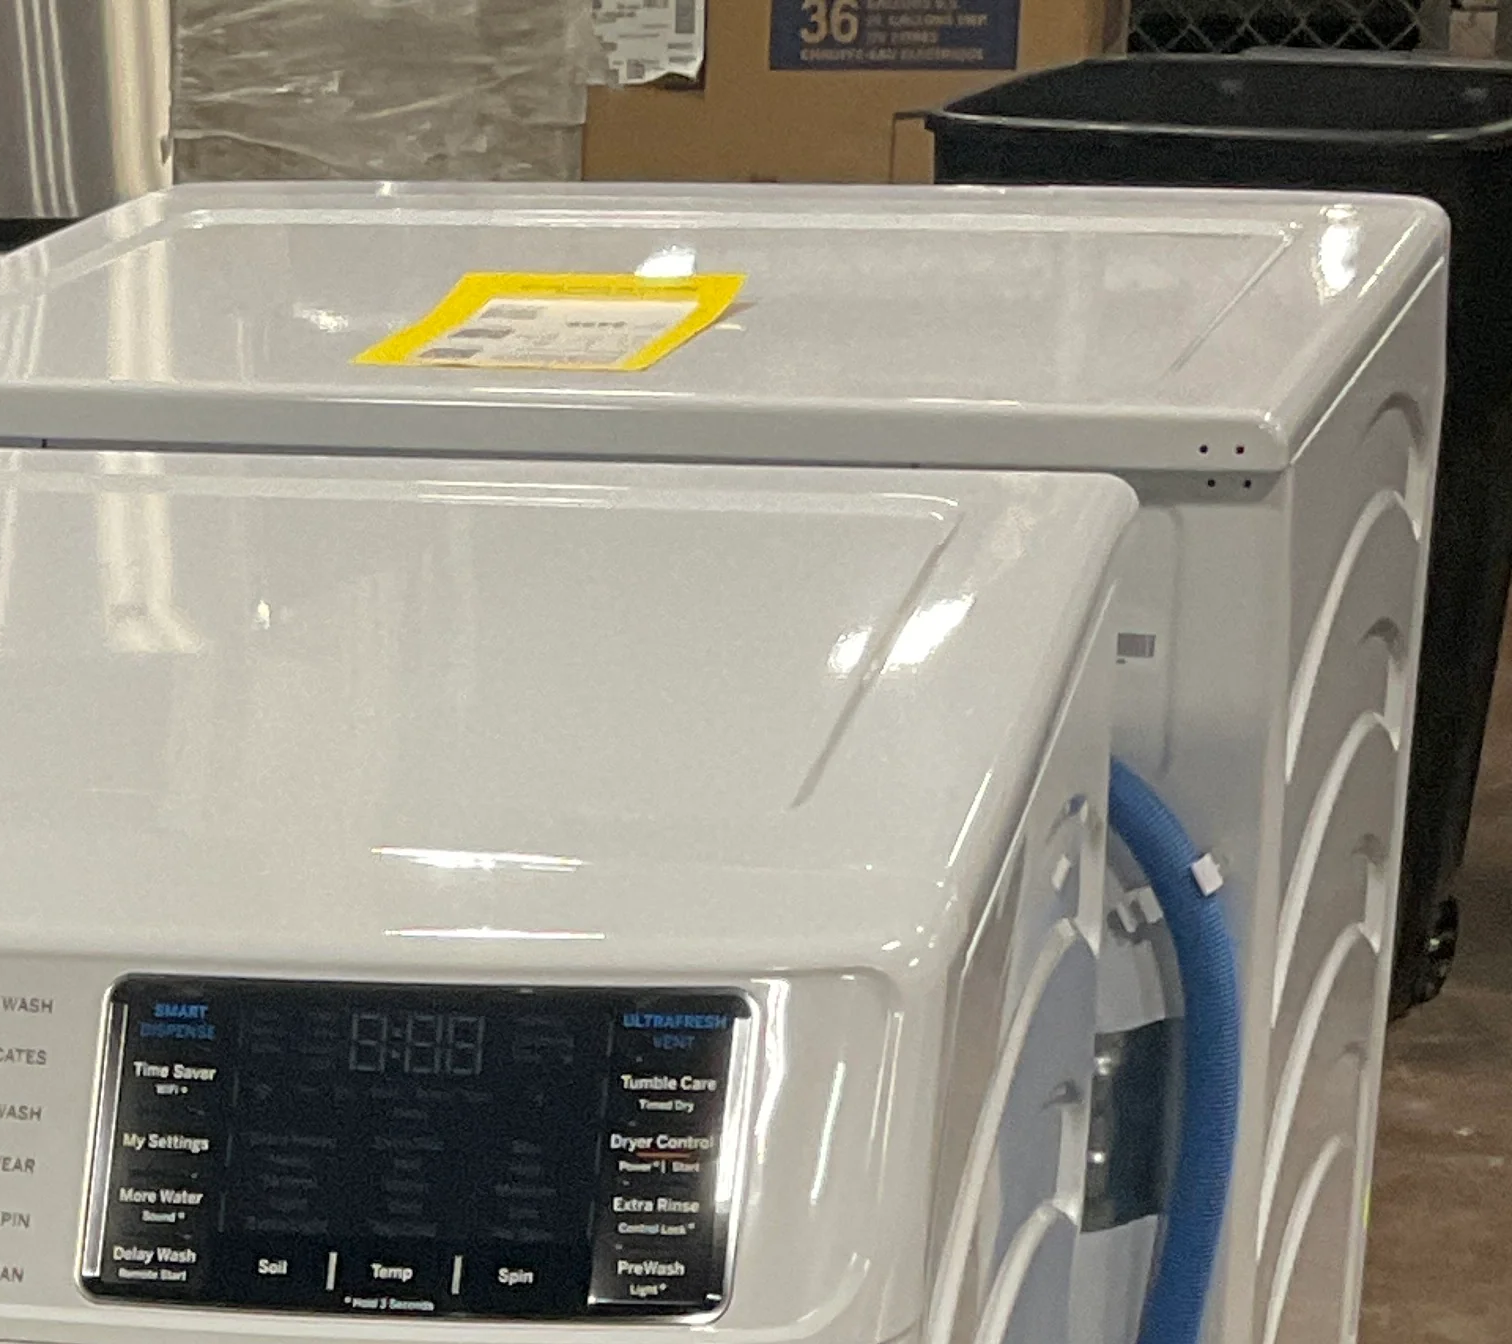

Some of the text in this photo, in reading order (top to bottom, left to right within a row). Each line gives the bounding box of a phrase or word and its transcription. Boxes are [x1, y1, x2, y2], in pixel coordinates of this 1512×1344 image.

[800, 0, 859, 44] 36
[2, 997, 54, 1014] WASH
[154, 1003, 208, 1019] SMART
[623, 1012, 727, 1030] ULTRAFRESH
[134, 1060, 218, 1082] Time Saver
[620, 1073, 718, 1092] Tumble Care
[122, 1132, 210, 1154] My Settings
[610, 1133, 715, 1153] Dryer Control
[119, 1187, 204, 1205] More Water
[613, 1196, 701, 1214] Extra Rinse
[112, 1245, 197, 1265] Delay Wash
[257, 1258, 289, 1276] Soil
[370, 1262, 414, 1283] Temp
[497, 1267, 535, 1286] Spin
[617, 1259, 686, 1277] PreWash
